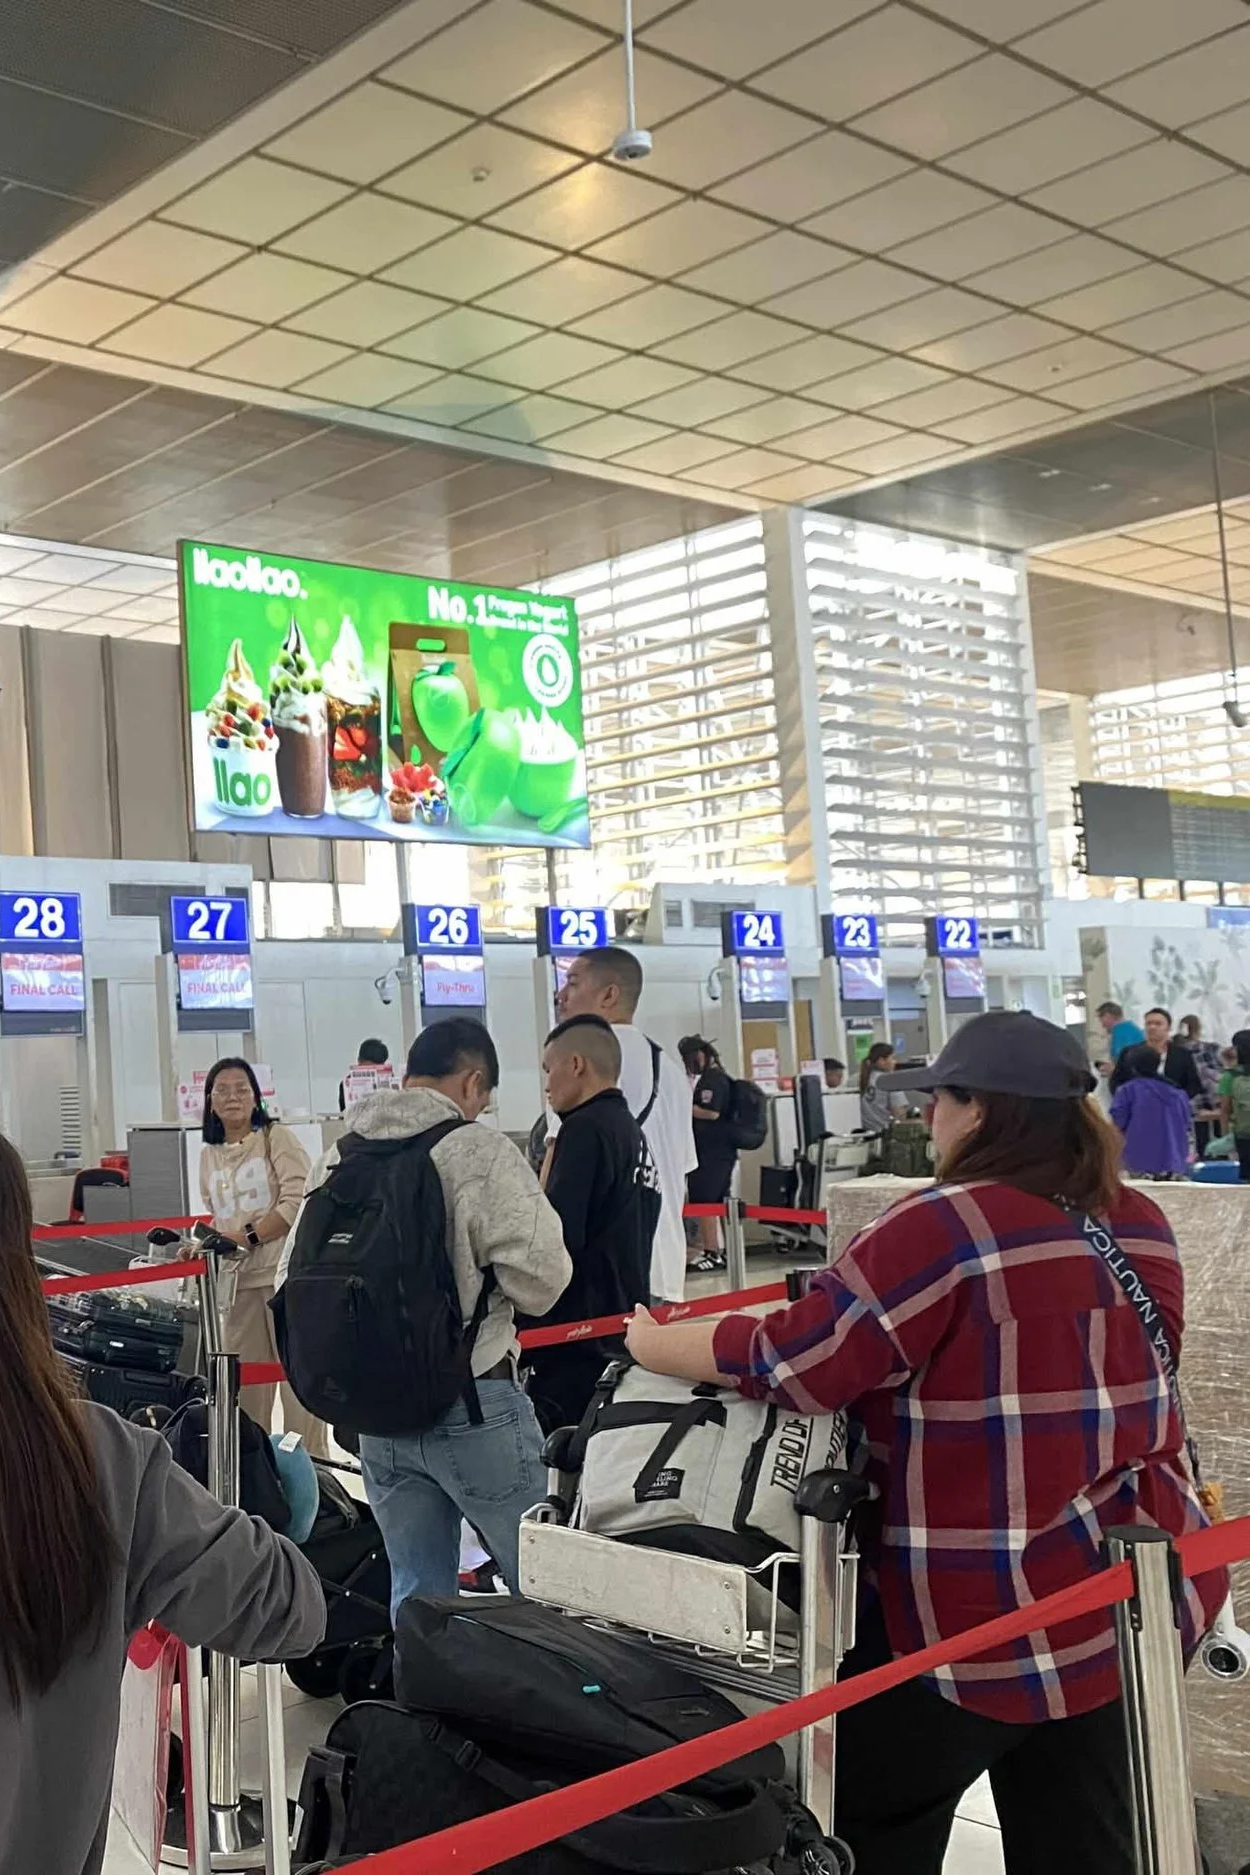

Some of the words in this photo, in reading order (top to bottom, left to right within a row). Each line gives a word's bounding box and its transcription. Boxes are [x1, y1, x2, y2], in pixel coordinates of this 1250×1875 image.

[427, 585, 487, 626] No.1
[213, 756, 271, 807] llao
[13, 897, 66, 938] 28
[187, 901, 232, 940] 27
[428, 908, 469, 944] 26
[560, 910, 598, 946] 25
[743, 914, 776, 947] 24
[843, 916, 871, 947] 23
[944, 919, 972, 948] 22
[10, 984, 45, 996] FINAL
[47, 984, 78, 996] CALL
[187, 982, 218, 994] FINAL
[220, 982, 246, 993] CALL
[1083, 1214, 1158, 1324] NAUTICA
[770, 1436, 805, 1495] TREND
